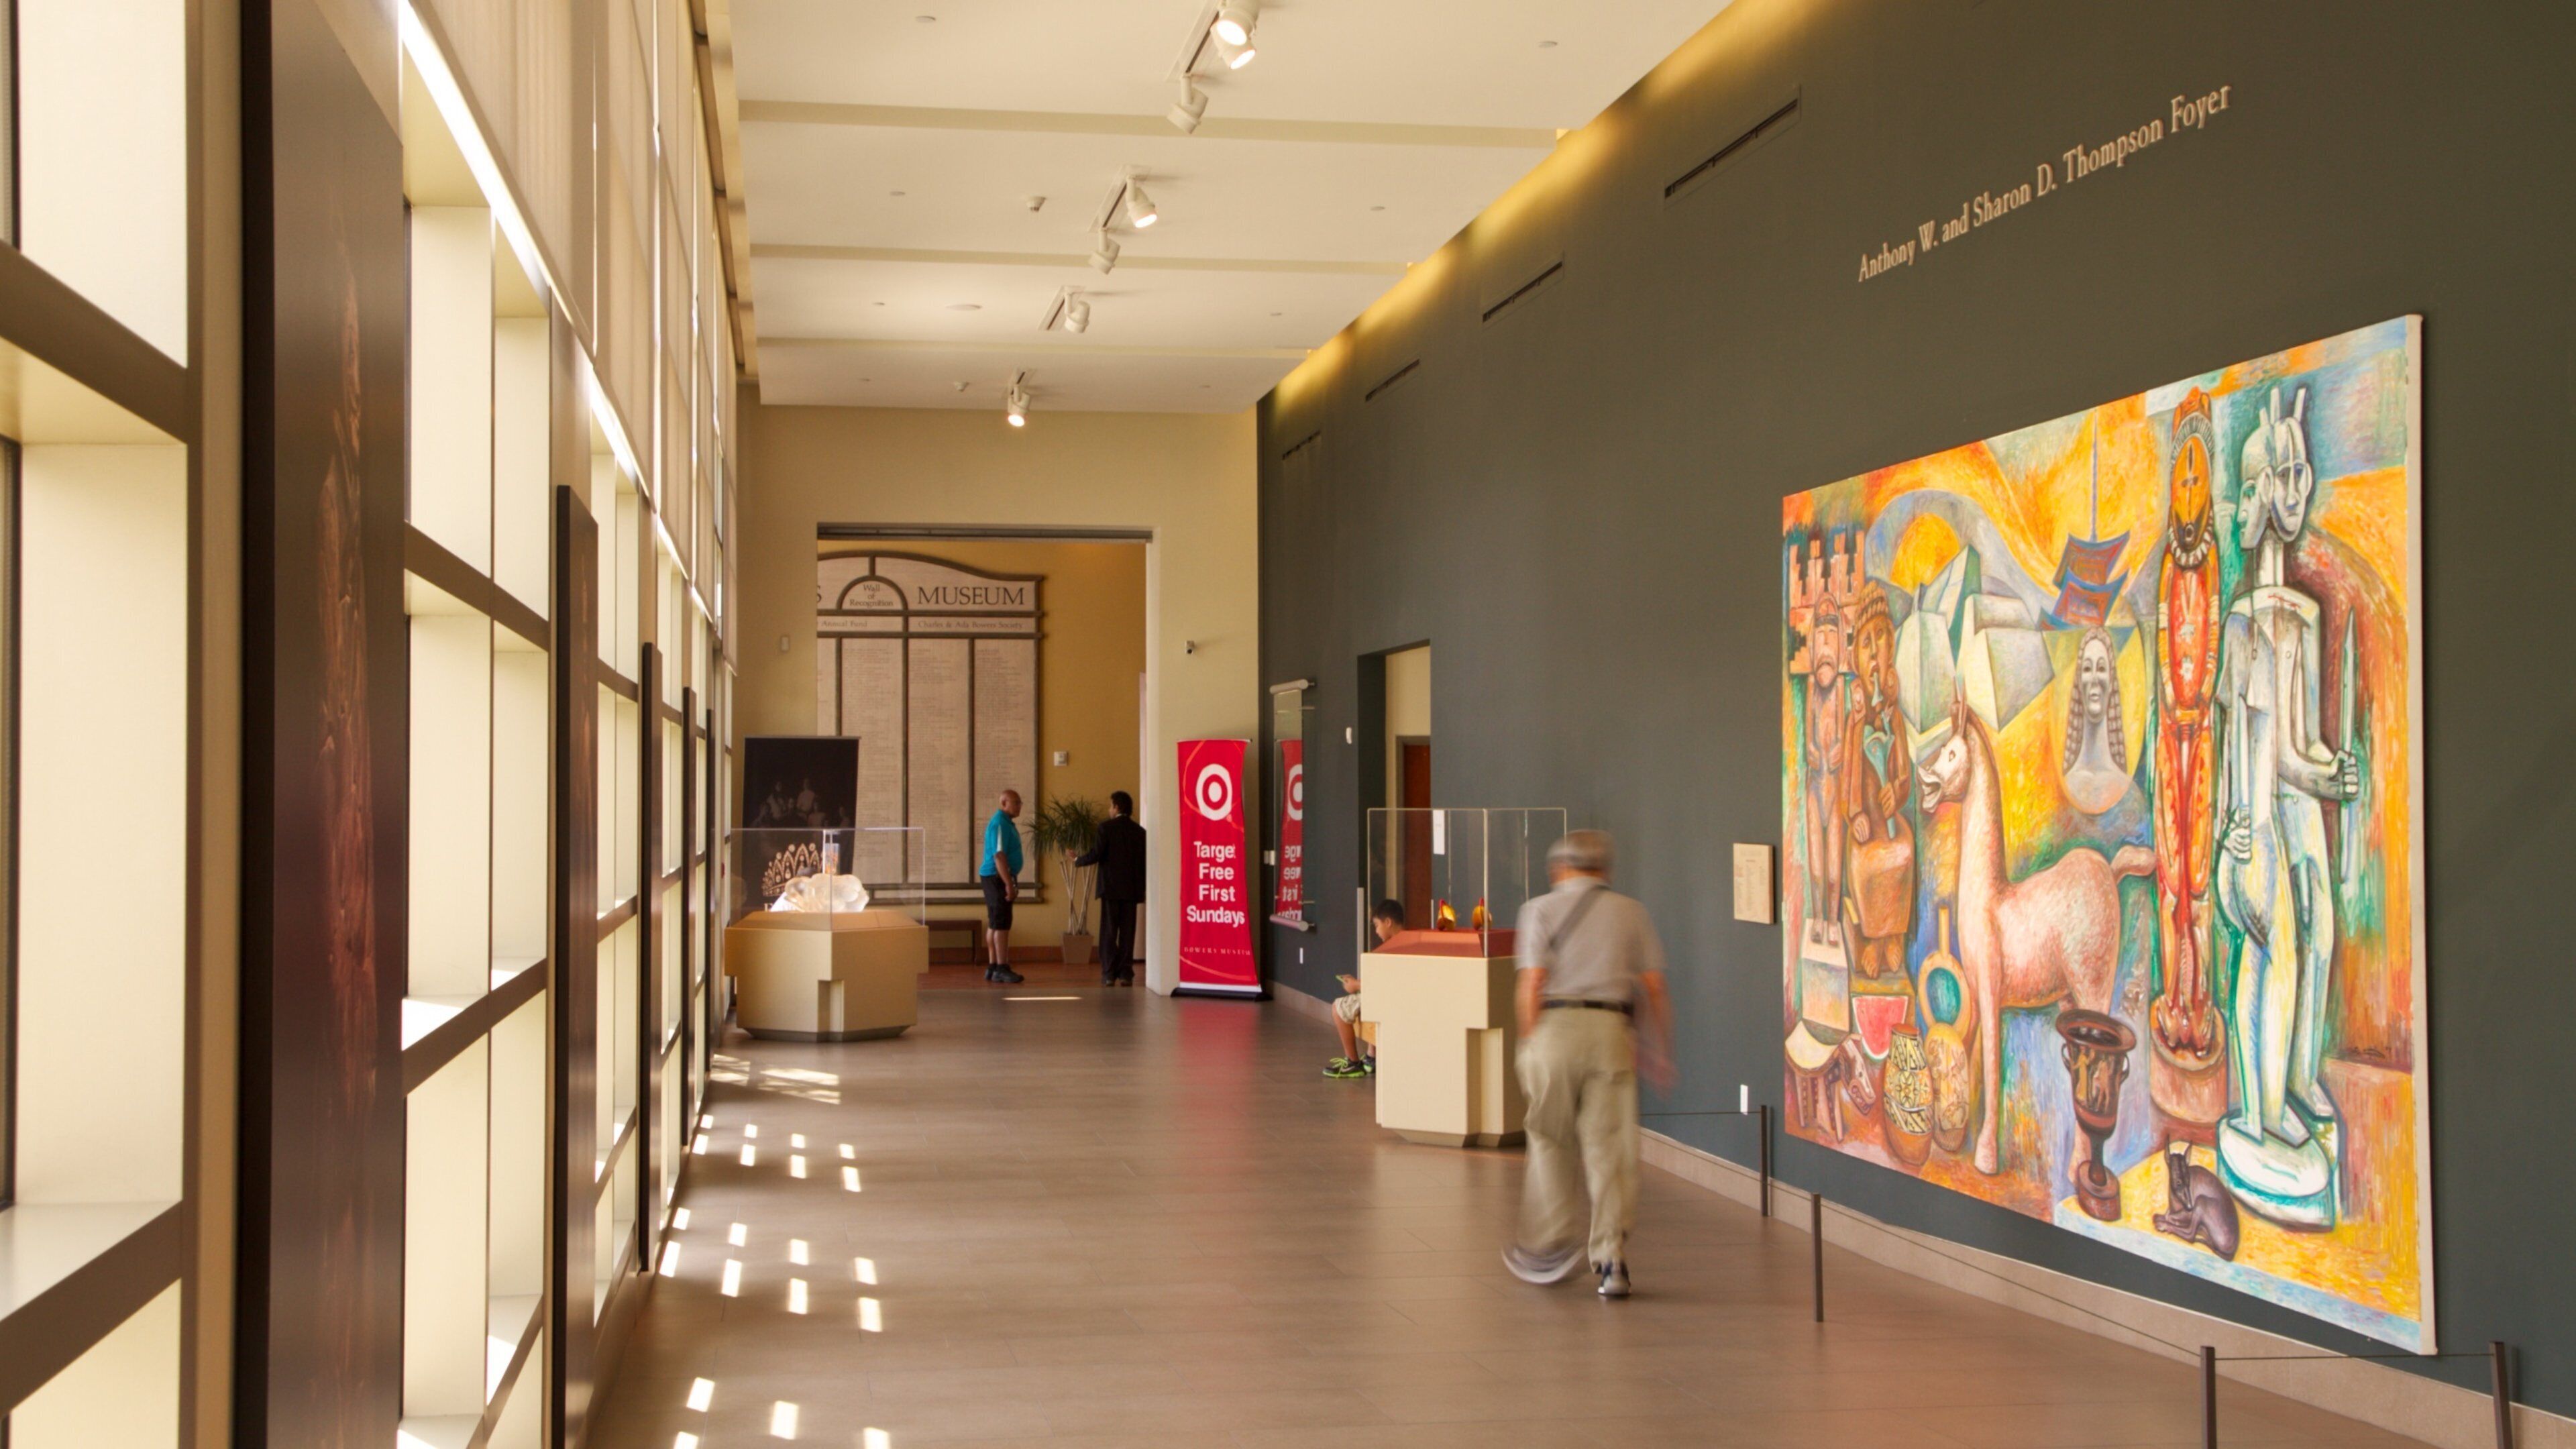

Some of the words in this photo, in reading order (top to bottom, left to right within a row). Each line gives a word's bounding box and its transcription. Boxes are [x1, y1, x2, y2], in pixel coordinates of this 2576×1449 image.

[1858, 241, 1916, 282] Anthony
[1918, 220, 1939, 254] W.
[1941, 203, 1970, 243] and
[1972, 182, 2032, 227] Sharon
[2037, 162, 2058, 197] D.
[2062, 117, 2164, 184] Thompson
[2170, 85, 2233, 133] Foyer
[863, 584, 880, 592] Wall
[918, 586, 1024, 605] MUSEUM
[849, 599, 894, 608] Recognition
[998, 621, 1022, 631] Society
[1199, 863, 1234, 880] Free
[1199, 884, 1236, 902] First
[1187, 905, 1245, 928] Sundays
